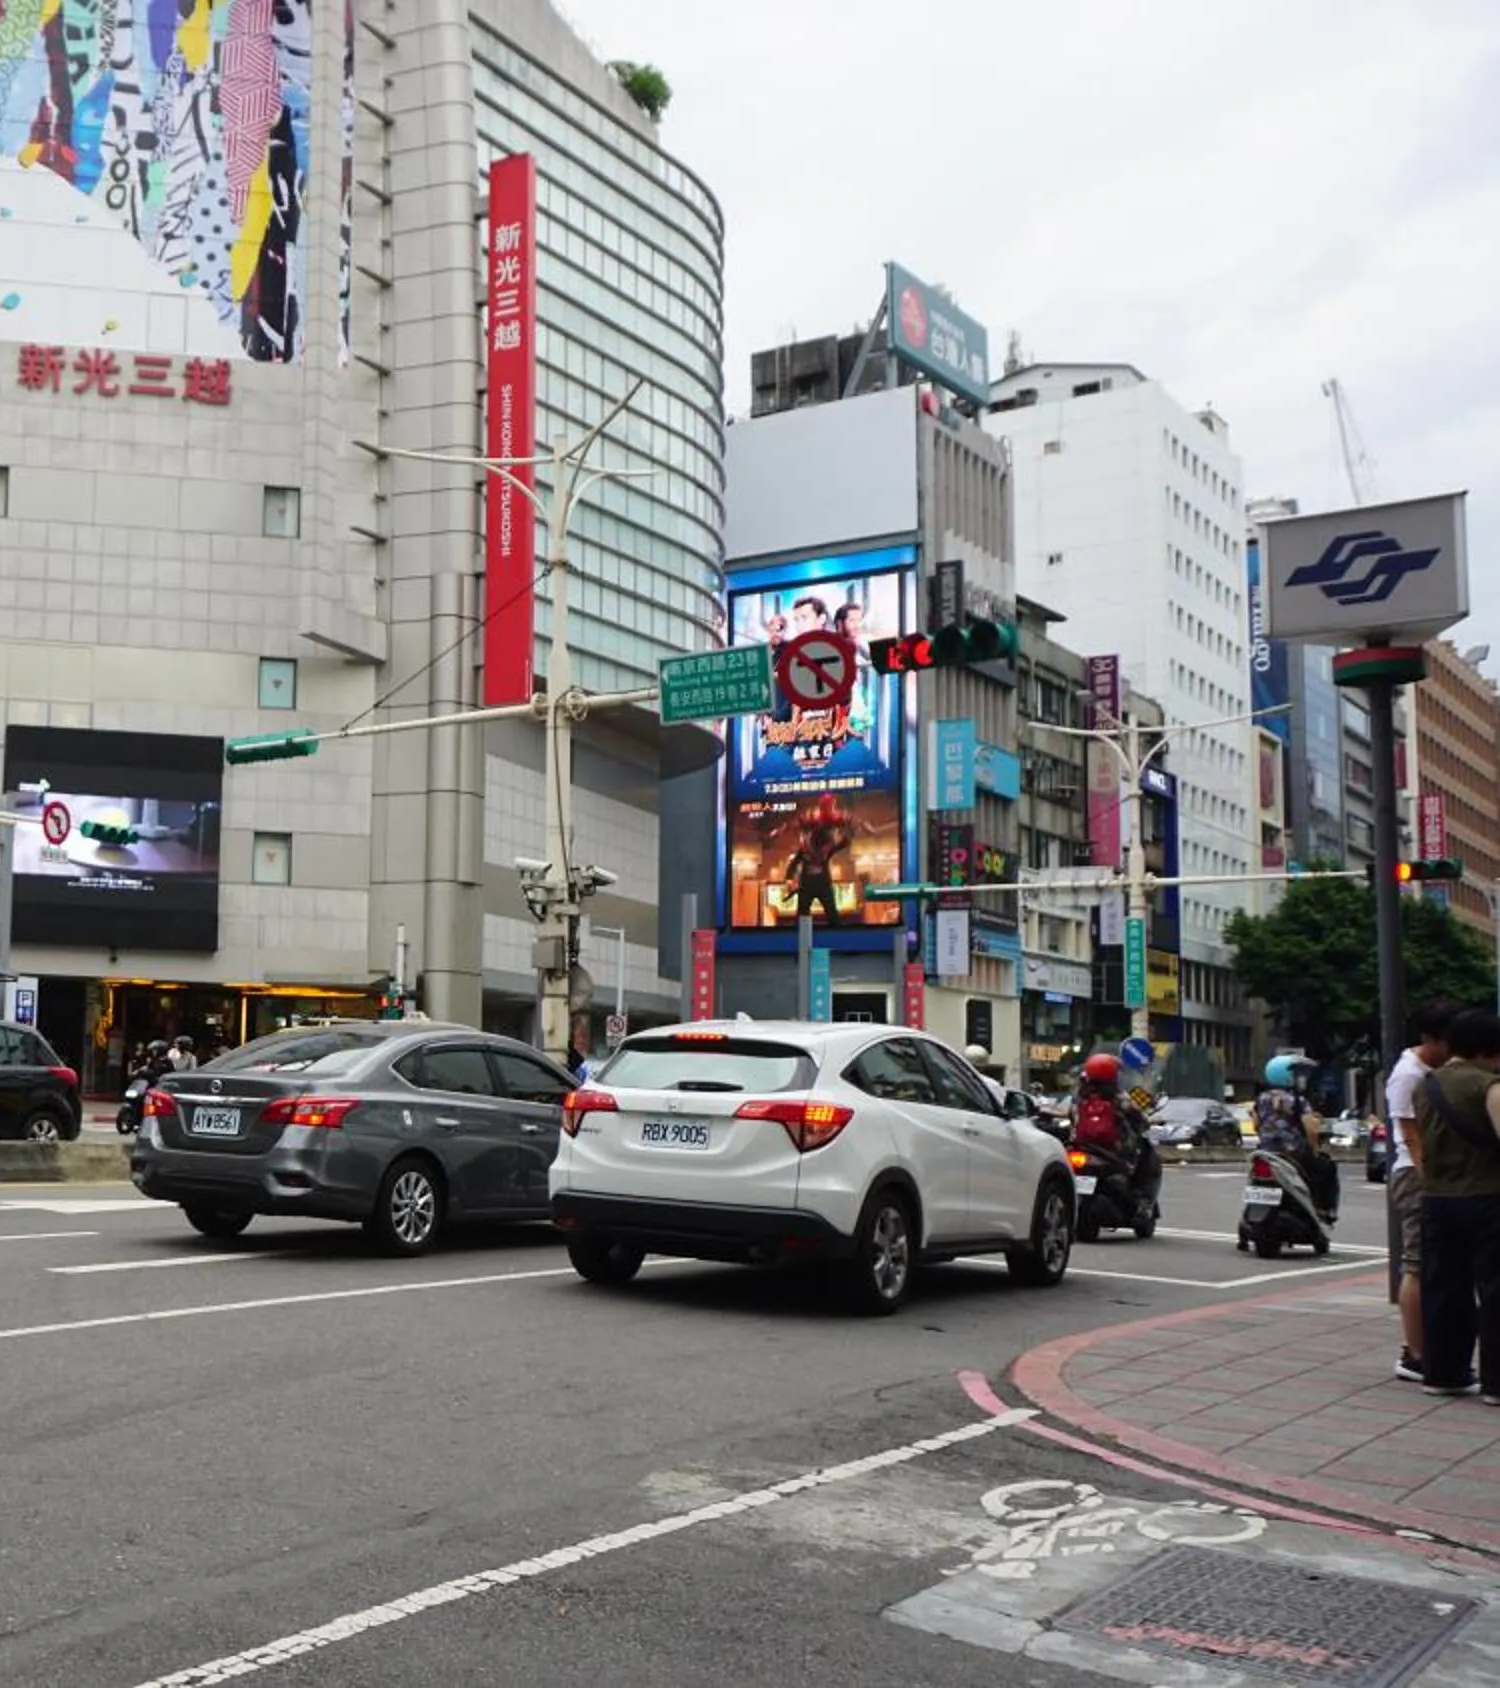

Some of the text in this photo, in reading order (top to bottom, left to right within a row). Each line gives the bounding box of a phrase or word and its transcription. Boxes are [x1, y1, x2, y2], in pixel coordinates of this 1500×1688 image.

[494, 221, 521, 352] 新光三越
[17, 344, 232, 405] 新光三越
